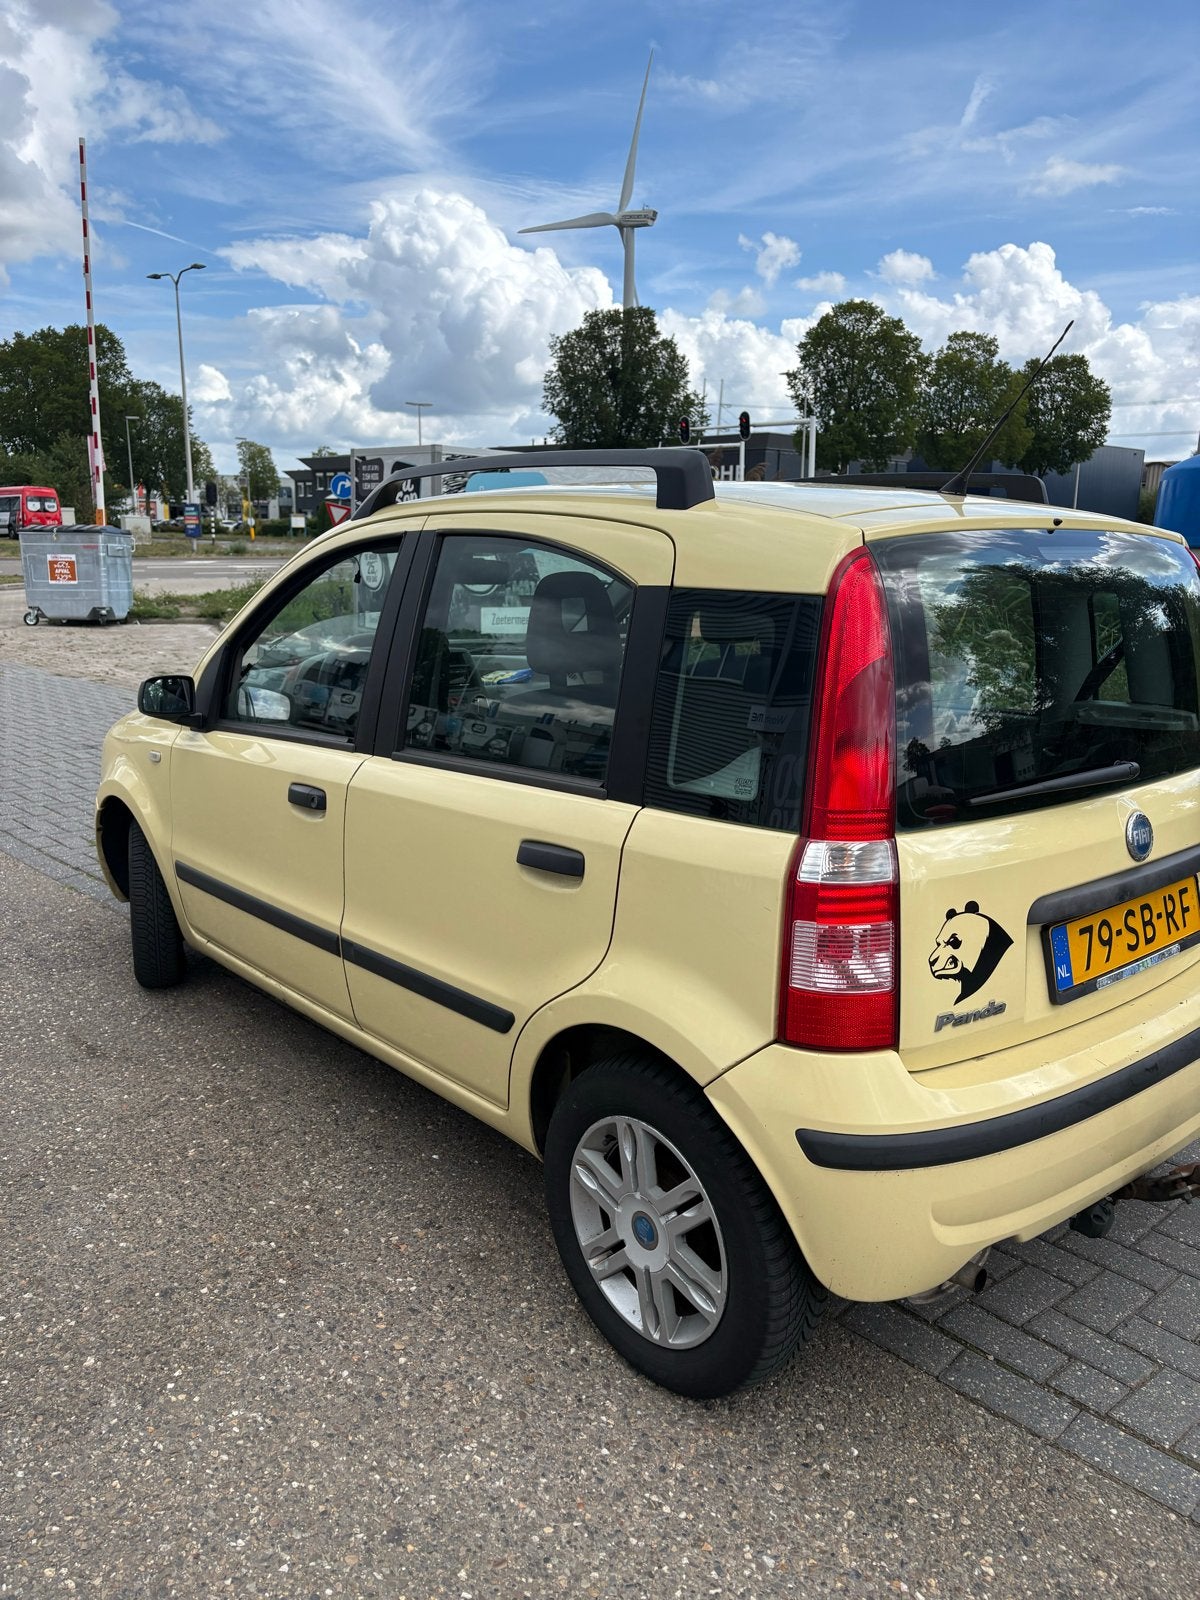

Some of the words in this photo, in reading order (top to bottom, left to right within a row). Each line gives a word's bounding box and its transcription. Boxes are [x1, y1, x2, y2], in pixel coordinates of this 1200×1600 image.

[1133, 827, 1150, 846] FIAT
[1078, 886, 1191, 972] 79-SB-RF
[1057, 963, 1070, 980] NL
[934, 1000, 1007, 1033] Panda
